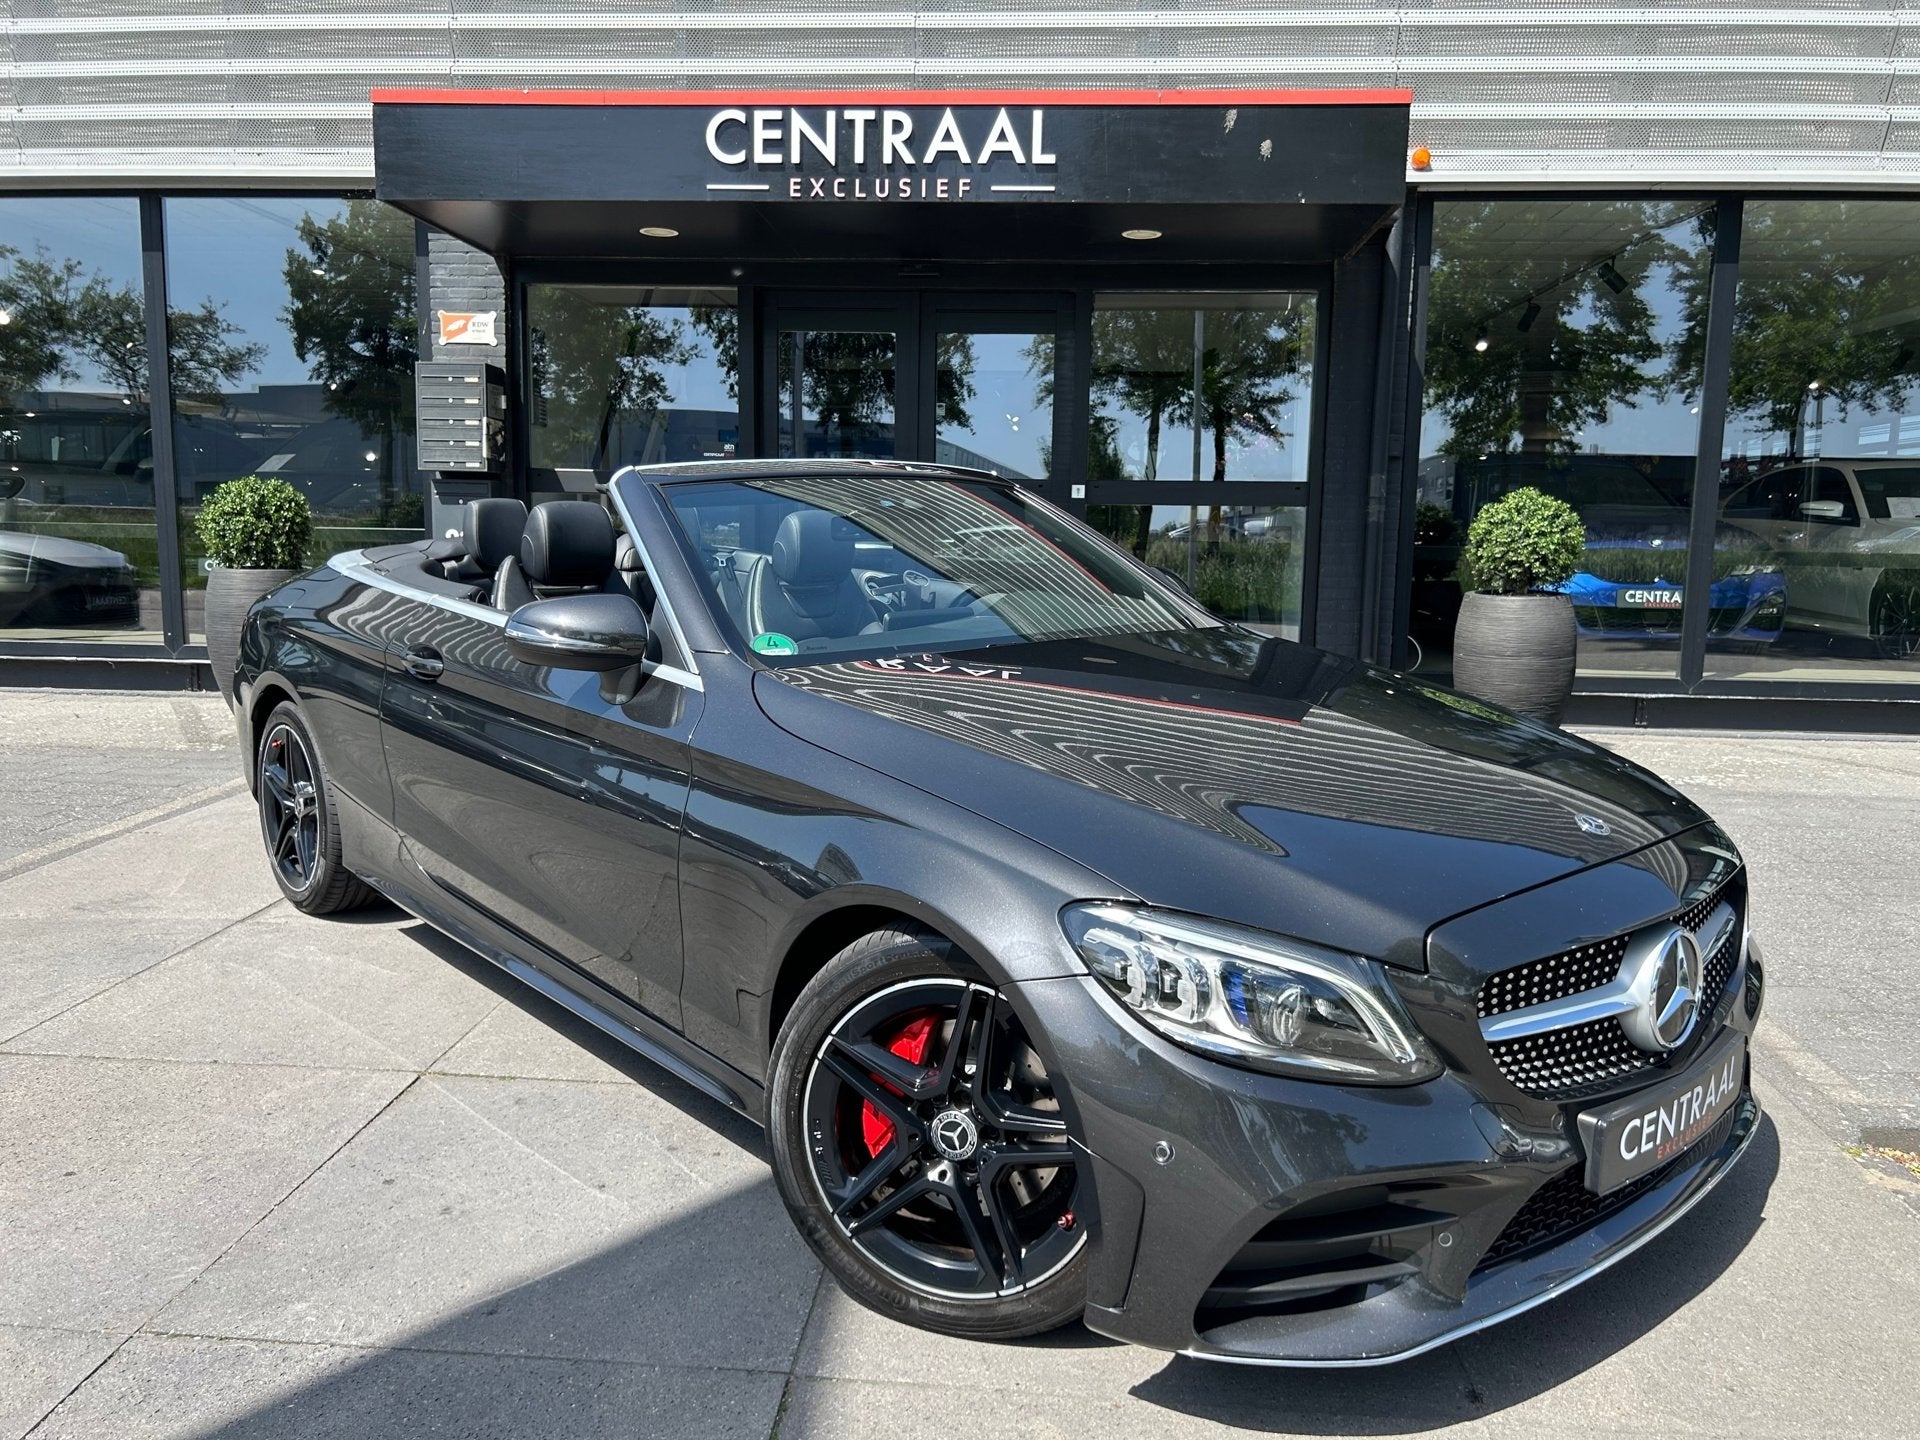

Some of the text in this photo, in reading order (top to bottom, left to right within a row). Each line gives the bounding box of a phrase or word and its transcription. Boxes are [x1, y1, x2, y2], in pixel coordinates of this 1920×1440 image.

[706, 107, 1056, 167] CENTRAAL
[789, 178, 972, 198] EXCLUSIEF
[767, 636, 779, 648] 4
[1620, 1055, 1735, 1160] CENTRAAL
[1656, 1112, 1713, 1160] EXCLUSIEF
